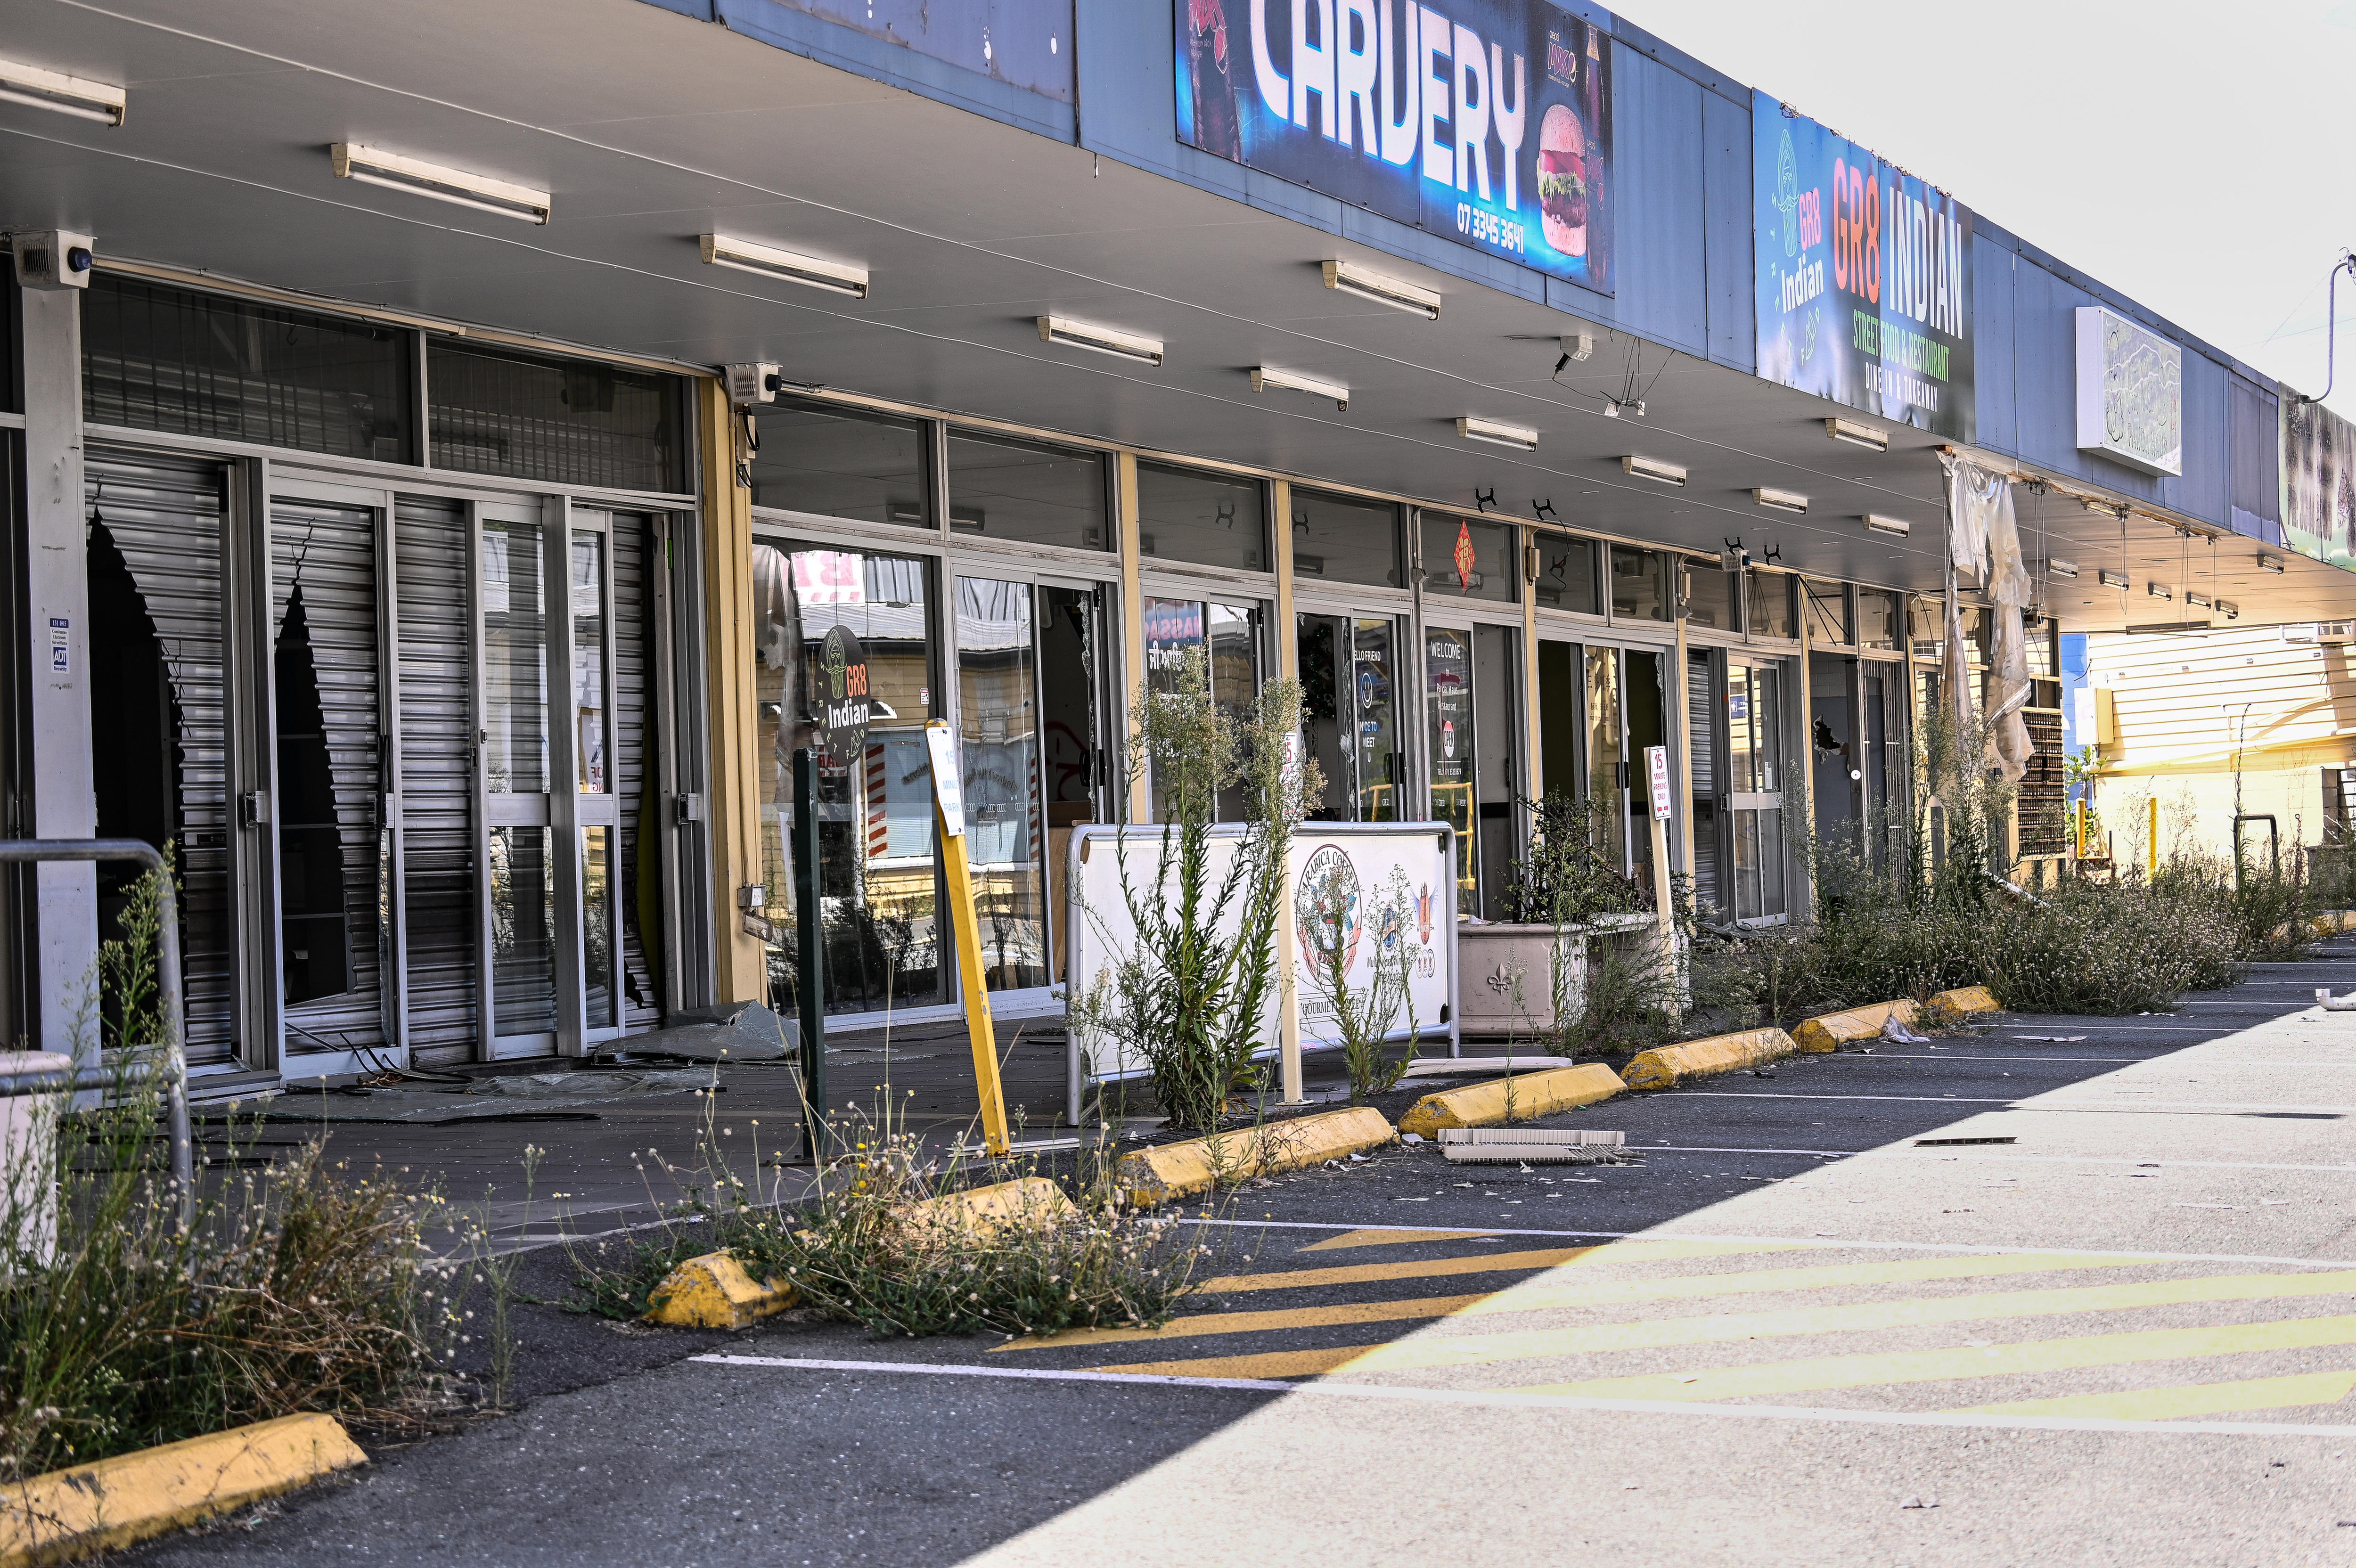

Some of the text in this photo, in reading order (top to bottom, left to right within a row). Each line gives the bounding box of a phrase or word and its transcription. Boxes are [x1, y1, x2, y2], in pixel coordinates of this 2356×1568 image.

[1799, 187, 1822, 251] GR8
[1457, 202, 1524, 255] 07 3345 3641
[1833, 157, 1963, 340] GR8 INDIAN
[1781, 253, 1824, 314] Indian
[1853, 309, 1949, 383] STREET FOOD & RESTAURANT
[1865, 361, 1938, 413] DINE IN & TAKEAWAY
[1459, 536, 1471, 574] 福
[54, 649, 67, 662] ADT
[1365, 651, 1381, 662] FRIEND
[1431, 641, 1461, 660] WELCOME
[846, 663, 867, 697] GR8
[1445, 668, 1450, 677] to
[1448, 685, 1458, 694] Haus
[828, 698, 869, 729] Indian
[1360, 721, 1377, 732] NICE TO
[1363, 737, 1375, 748] MEET
[1444, 730, 1454, 747] OPEN
[946, 750, 955, 765] 15
[1367, 752, 1371, 763] U
[1655, 753, 1662, 769] 15
[943, 780, 959, 790] MINU
[944, 802, 961, 813] PARK
